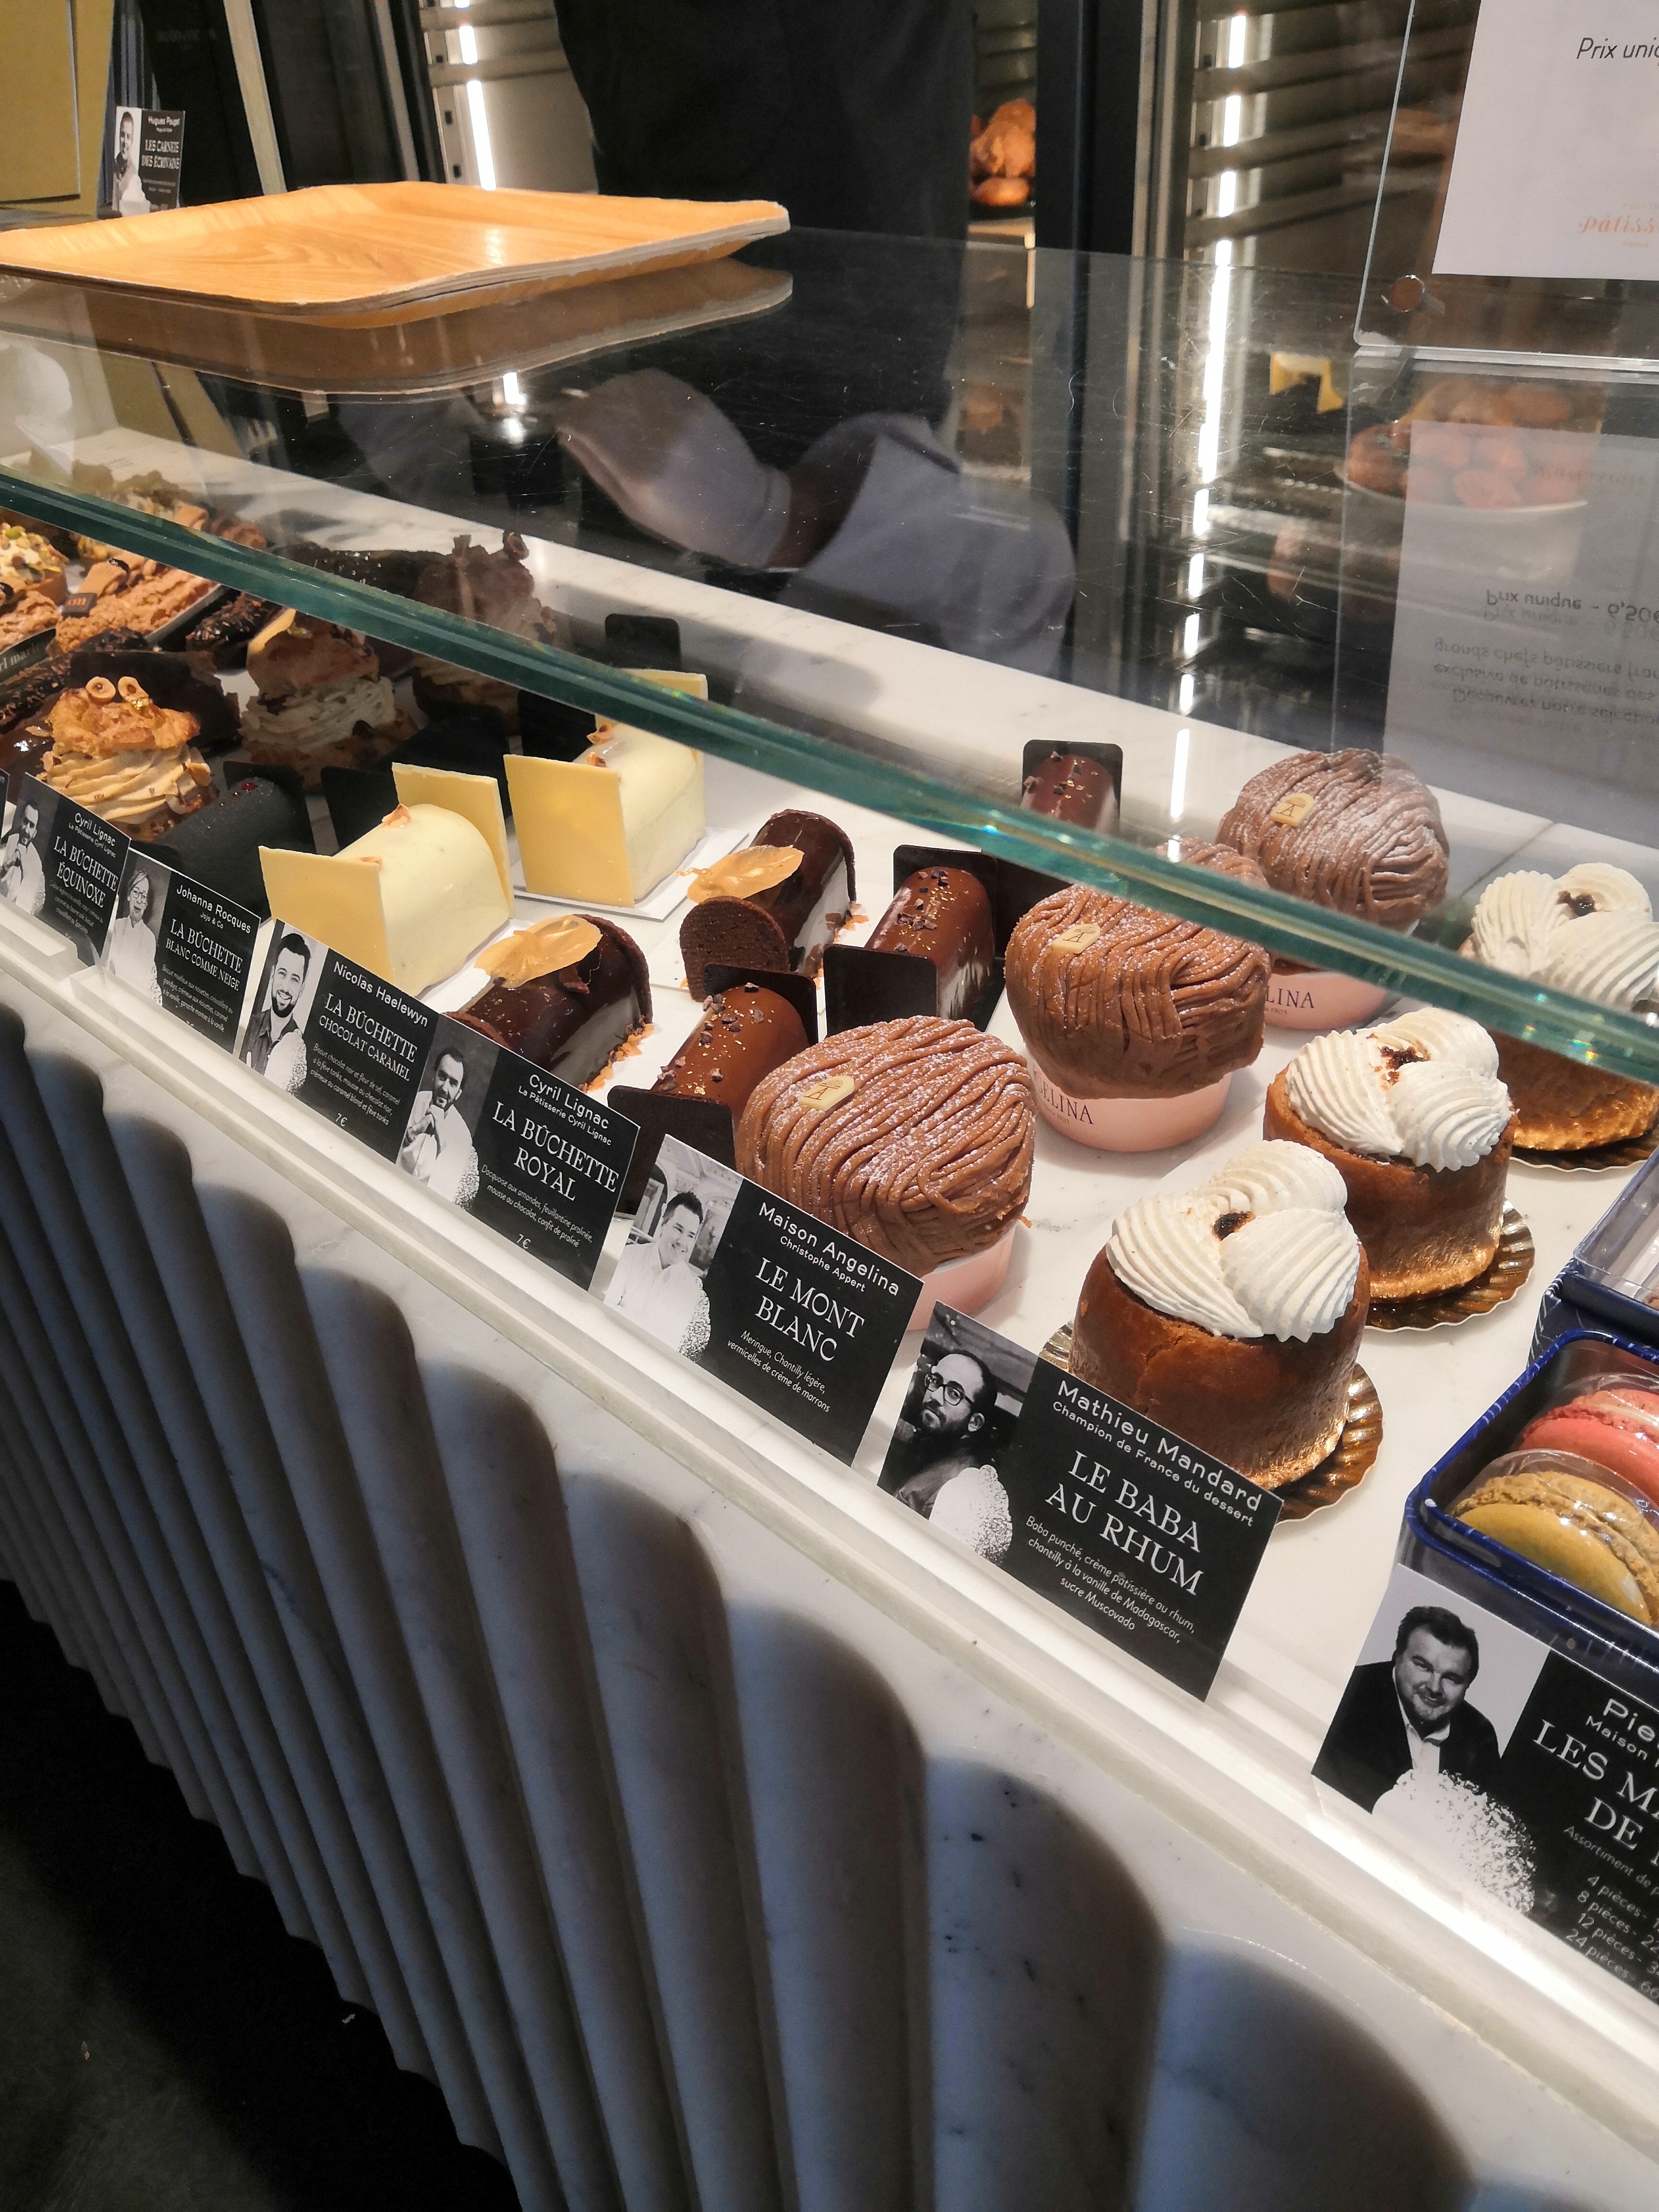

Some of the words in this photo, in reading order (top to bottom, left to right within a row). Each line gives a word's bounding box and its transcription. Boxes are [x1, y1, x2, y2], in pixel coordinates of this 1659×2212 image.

[1576, 37, 1617, 60] Prix
[75, 813, 93, 830] Cyril
[93, 824, 116, 847] Lignac
[54, 836, 67, 857] LA
[69, 845, 119, 891] BÛCHETTE
[57, 861, 106, 908] ÉQUINOXE
[177, 885, 213, 912] Johanna
[216, 904, 251, 934] Rocques
[200, 913, 211, 922] Jojo
[217, 920, 224, 929] Co
[166, 938, 191, 960] BLANC
[192, 953, 218, 977] COMME
[218, 969, 240, 991] NEIGE
[170, 918, 184, 939] LA
[187, 927, 243, 974] BÛCHETTE
[334, 961, 373, 993] Nicolas
[376, 986, 428, 1027] Haelewyn
[319, 1015, 368, 1052] CHOCOLAT
[368, 1046, 410, 1082] CARAMEL
[325, 993, 342, 1018] LA
[346, 1006, 418, 1063] BÛCHETTE
[313, 1043, 328, 1058] Biscuit
[327, 1054, 346, 1070] chocolat
[382, 1091, 401, 1105] caramel
[334, 1085, 351, 1099] caramel
[350, 1094, 363, 1107] blond
[343, 1078, 360, 1092] mousse
[365, 1092, 384, 1108] chocolat
[529, 1074, 561, 1101] Cyril
[564, 1093, 610, 1129] Lignac
[1034, 1066, 1094, 1124] GELINA
[336, 1113, 348, 1127] 7€
[518, 1085, 528, 1096] La
[529, 1091, 566, 1118] Pâtisserie
[567, 1115, 586, 1130] Cyril
[587, 1125, 612, 1146] Lignac
[492, 1101, 516, 1132] LA
[520, 1118, 619, 1193] BÛCHETTE
[514, 1147, 577, 1201] ROYAL
[481, 1164, 508, 1187] Dacquoise
[507, 1183, 517, 1193] aux
[517, 1190, 542, 1210] amandes,
[541, 1202, 571, 1227] feuillantine
[570, 1223, 593, 1244] pralinée,
[487, 1184, 506, 1201] mousse
[506, 1197, 514, 1205] au
[513, 1200, 537, 1222] chocolat,
[538, 1215, 553, 1232] confit
[553, 1226, 562, 1237] de
[560, 1230, 581, 1248] praliné
[516, 1234, 531, 1249] 7€
[758, 1202, 817, 1247] Maison
[822, 1241, 900, 1296] Angelina
[780, 1236, 830, 1271] Christophe
[832, 1266, 866, 1292] Appert
[755, 1257, 789, 1292] LE
[789, 1277, 865, 1338] MONT
[755, 1295, 838, 1361] BLANC
[727, 1340, 762, 1367] vermicelles
[762, 1362, 771, 1373] de
[771, 1369, 793, 1387] crème
[793, 1382, 801, 1393] de
[801, 1390, 830, 1412] marrons
[741, 1330, 772, 1359] Meringue,
[774, 1351, 804, 1379] Chantilly
[804, 1370, 826, 1394] légère,
[1053, 1401, 1112, 1443] Champion
[1116, 1439, 1131, 1453] de
[1135, 1449, 1180, 1482] France
[1184, 1478, 1199, 1494] du
[1204, 1491, 1254, 1527] dessert
[1058, 1380, 1149, 1445] Mathieu
[1157, 1437, 1262, 1512] Mandard
[1068, 1450, 1111, 1494] LE
[1115, 1478, 1201, 1552] BABA
[1045, 1483, 1097, 1524] AU
[1099, 1513, 1204, 1596] RHUM
[1026, 1515, 1048, 1538] Baba
[1048, 1533, 1082, 1561] punché,
[1084, 1554, 1113, 1577] crème
[1156, 1601, 1168, 1613] au
[1169, 1608, 1195, 1634] rhum,
[1028, 1538, 1064, 1567] chantilly
[1065, 1560, 1072, 1570] à
[1072, 1563, 1082, 1576] la
[1082, 1572, 1109, 1595] vanille
[1111, 1590, 1123, 1603] de
[1123, 1599, 1181, 1644] Madagascar,
[1060, 1577, 1085, 1598] sucre
[1085, 1594, 1135, 1631] Muscovado
[1586, 1715, 1648, 1760] Maison
[1603, 1698, 1659, 1750] Pie
[1533, 1719, 1609, 1781] LES
[1616, 1771, 1659, 1820] M
[1585, 1797, 1644, 1850] DE
[1563, 1826, 1634, 1876] Assortiment
[1635, 1874, 1652, 1888] de
[1577, 1890, 1590, 1903] 8
[1587, 1901, 1630, 1934] pièces
[1587, 1875, 1600, 1887] 4
[1597, 1885, 1641, 1917] pièces
[1566, 1928, 1587, 1948] 24
[1578, 1913, 1594, 1929] 12
[1592, 1928, 1635, 1960] pièces
